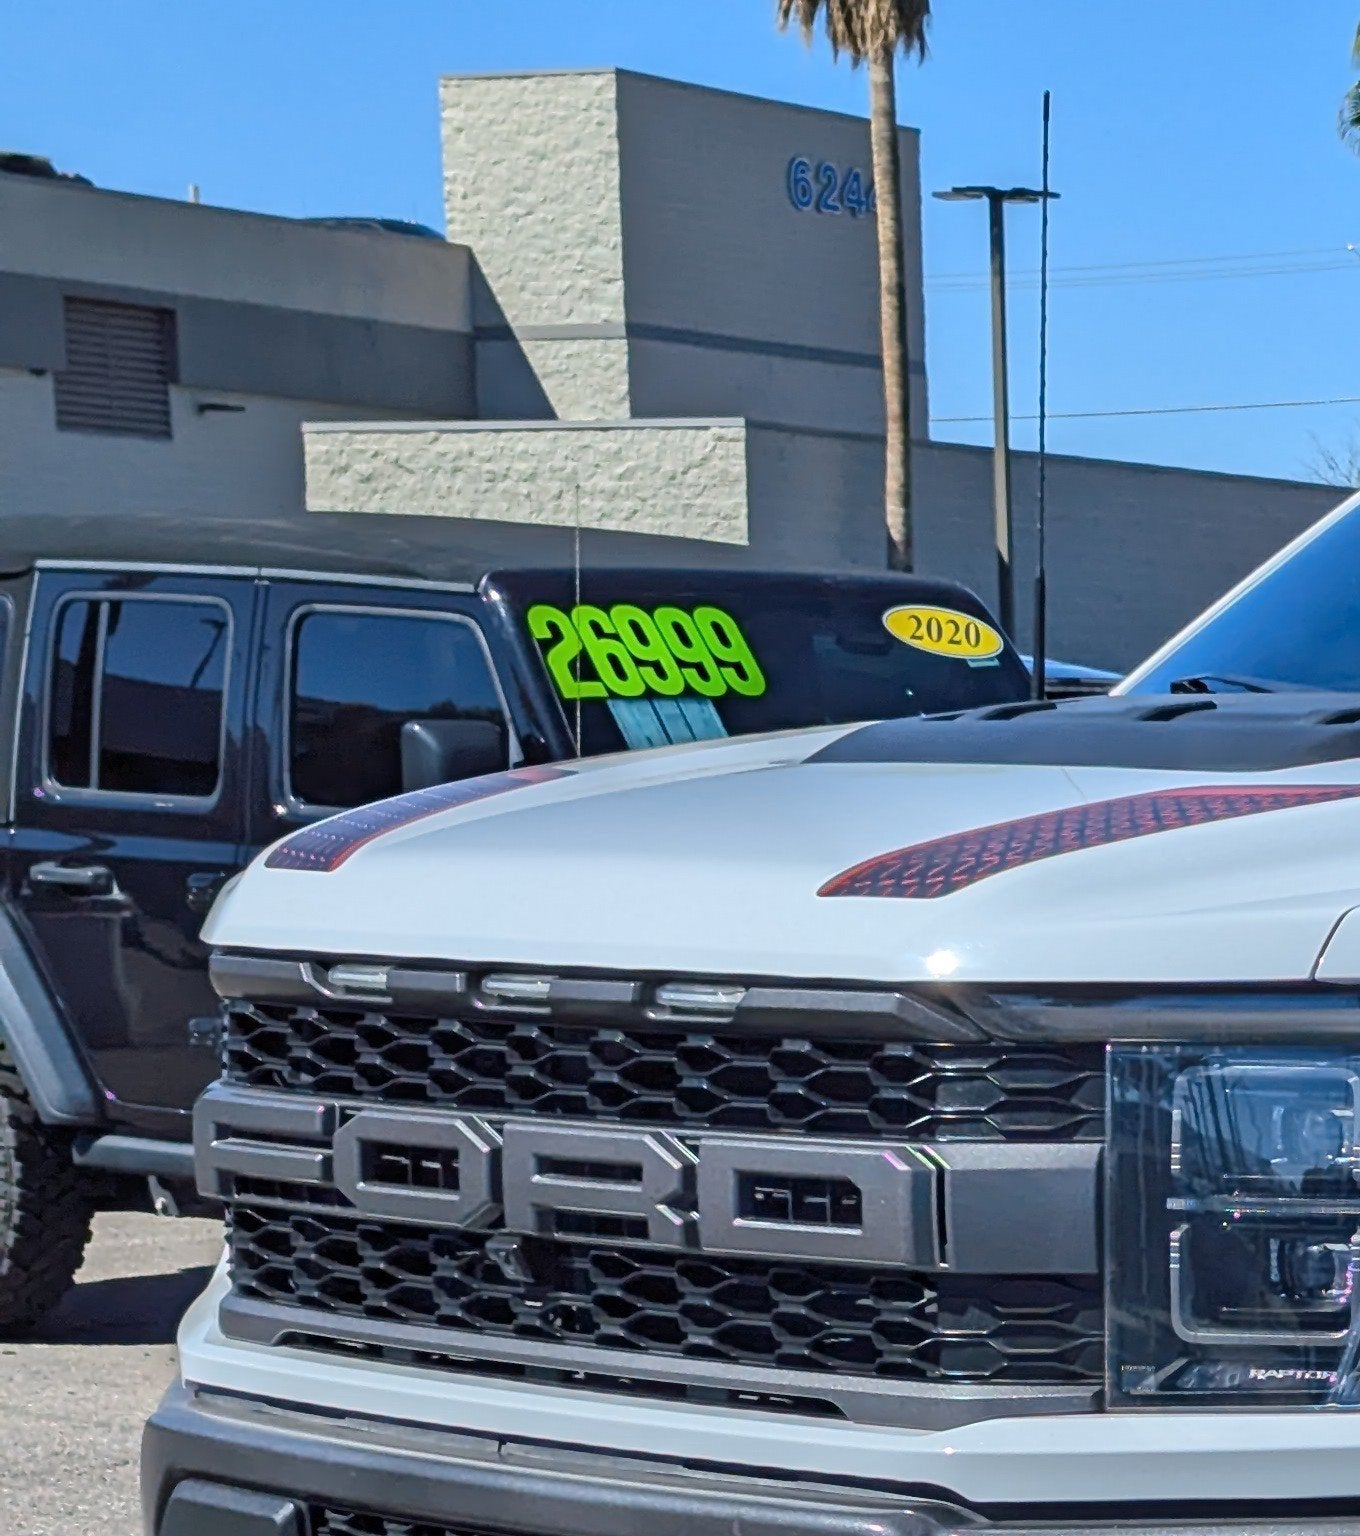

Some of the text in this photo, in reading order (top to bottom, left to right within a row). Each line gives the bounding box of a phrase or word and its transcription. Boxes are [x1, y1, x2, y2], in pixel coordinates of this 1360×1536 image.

[527, 604, 766, 699] 26999
[907, 614, 981, 648] 2020
[192, 1080, 937, 1266] FORD
[1248, 1368, 1338, 1383] RAPTOR
